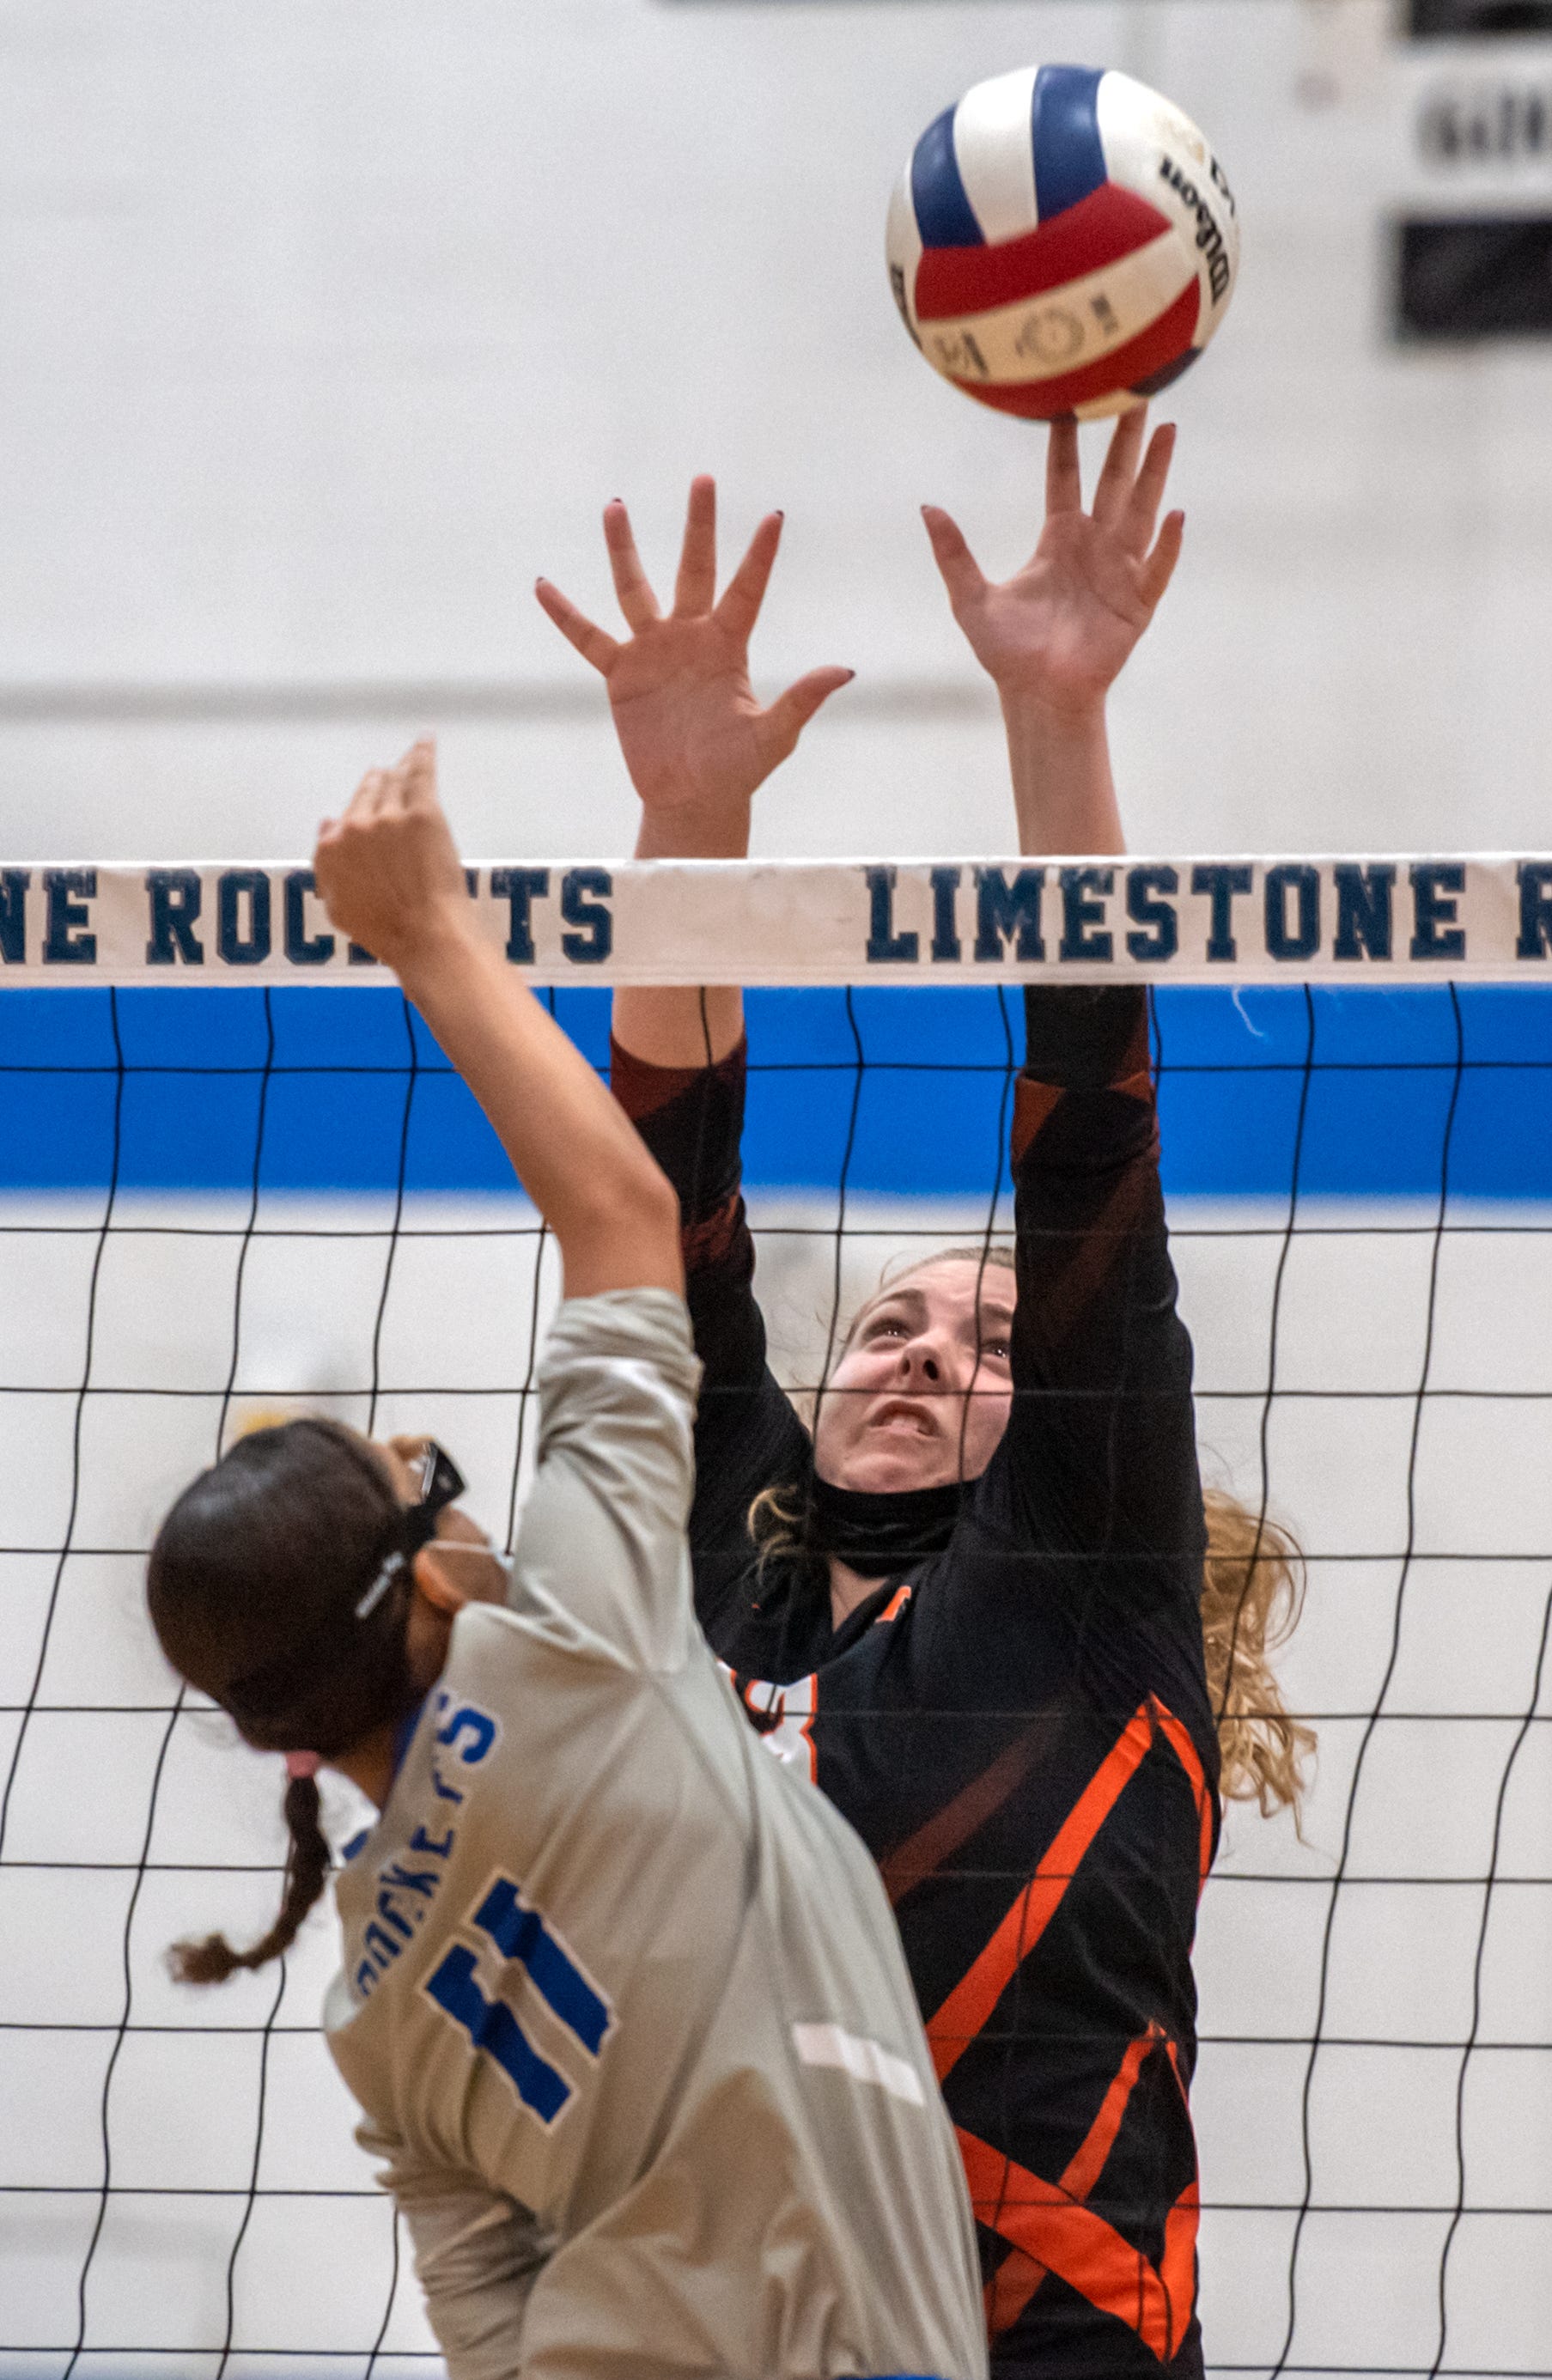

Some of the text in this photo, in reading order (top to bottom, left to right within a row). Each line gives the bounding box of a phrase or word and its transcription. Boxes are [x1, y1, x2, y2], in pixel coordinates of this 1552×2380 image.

[1160, 155, 1230, 307] Wilson
[144, 866, 612, 965] ROCTS
[865, 861, 1466, 963] LIMESTONE
[424, 1874, 616, 2125] 11
